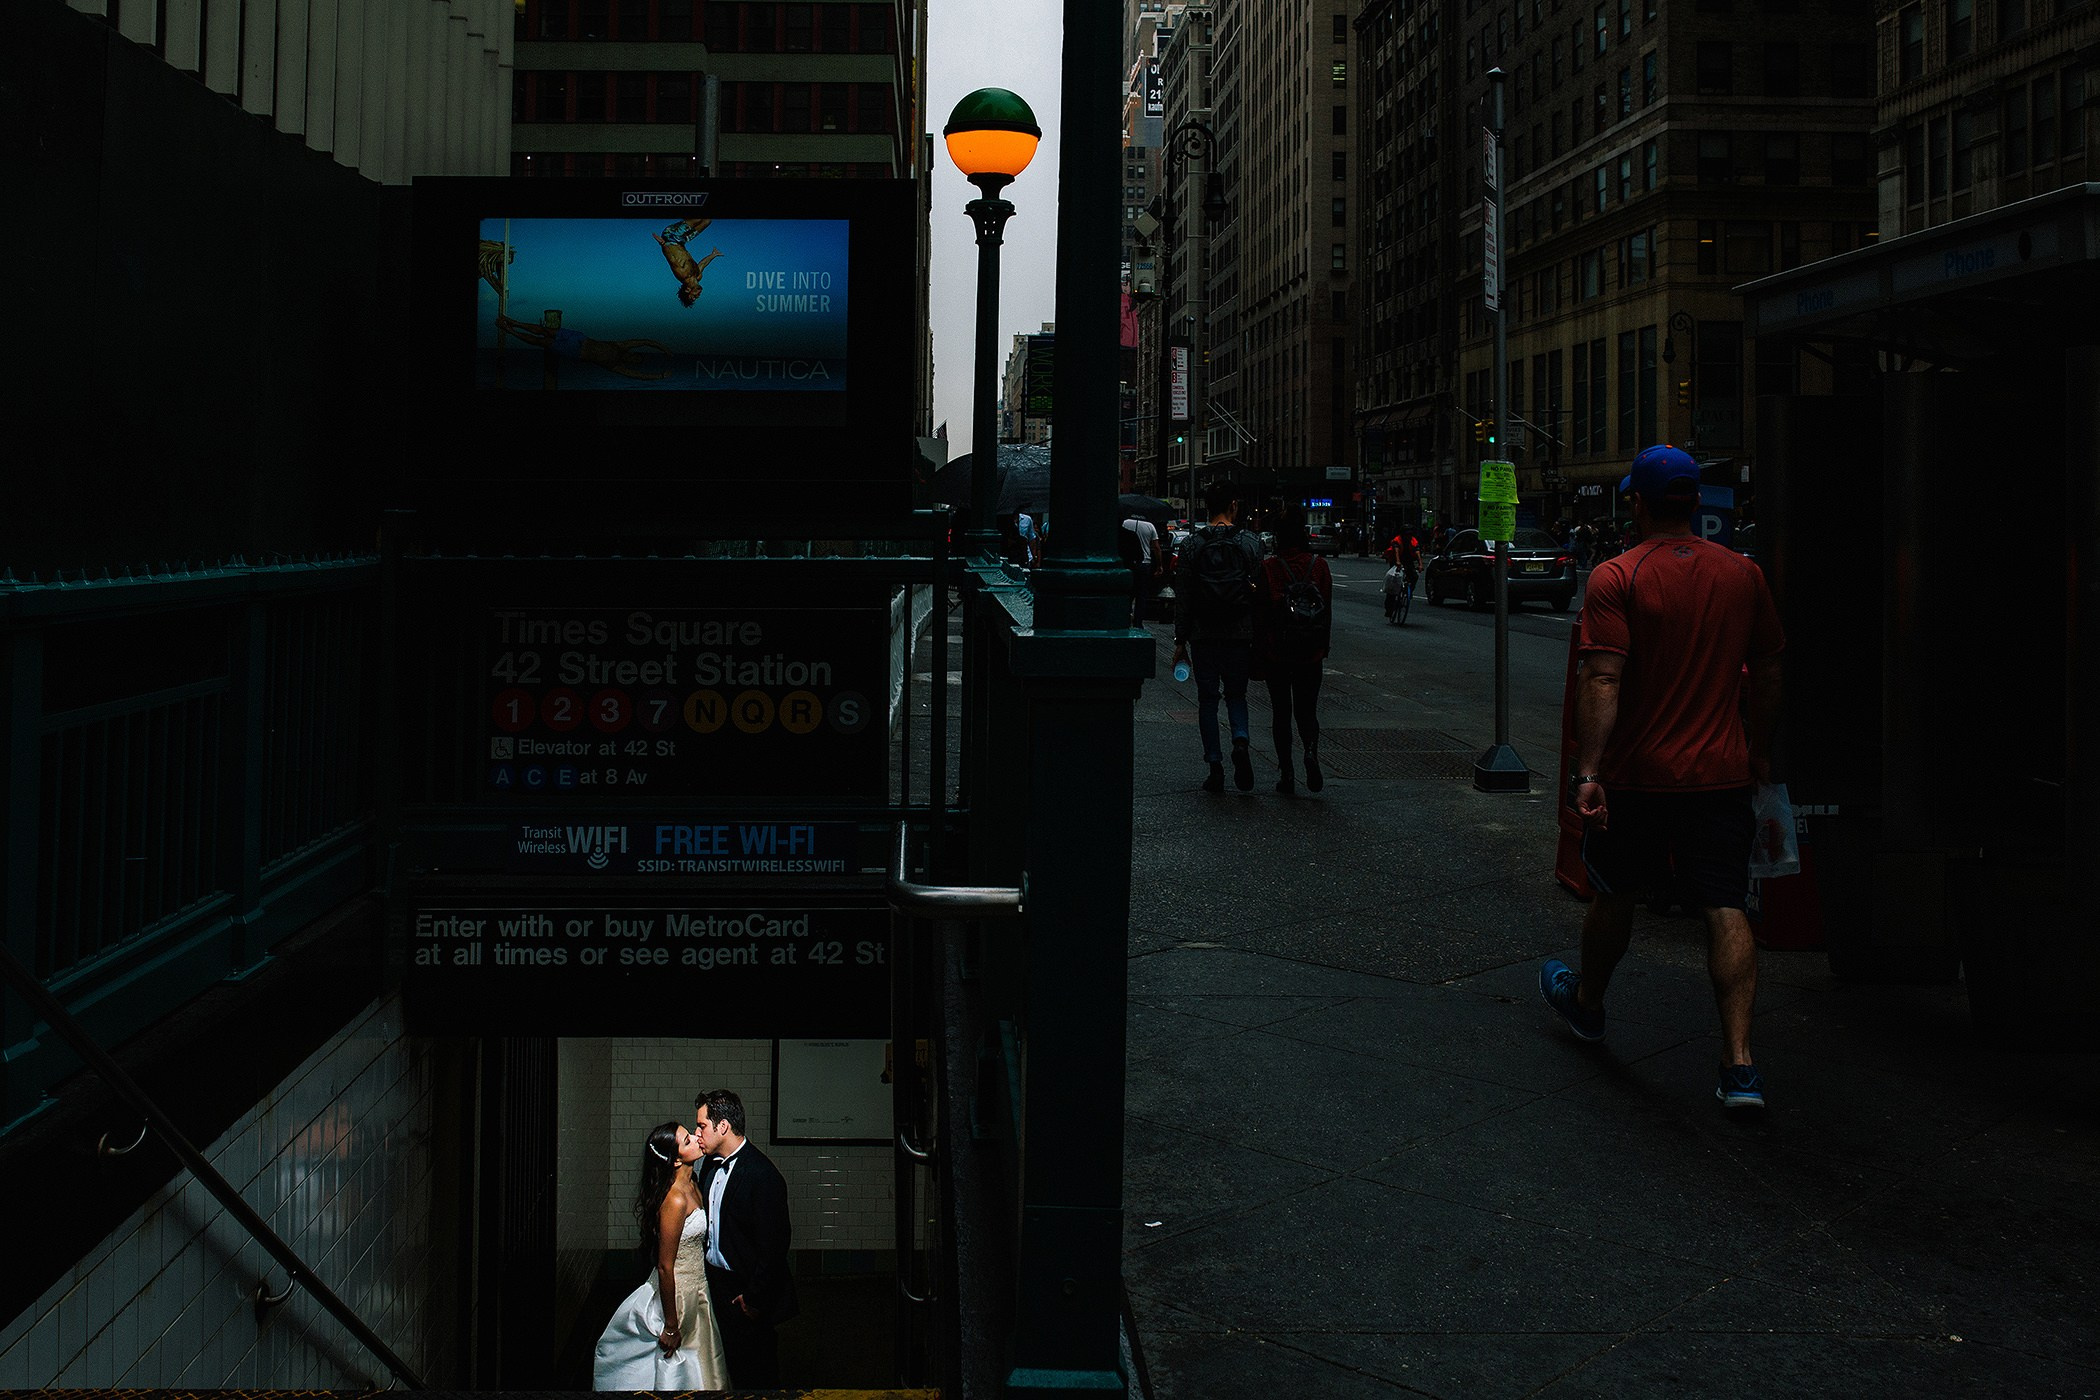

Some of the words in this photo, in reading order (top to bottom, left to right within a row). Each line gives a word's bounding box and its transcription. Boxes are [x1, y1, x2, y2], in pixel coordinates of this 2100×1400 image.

[626, 194, 703, 204] OUTFRONT
[1944, 248, 1995, 277] Phone
[747, 272, 785, 289] DIVE
[794, 272, 830, 289] INTO
[756, 294, 831, 313] SUMMER
[1797, 289, 1834, 313] Phone
[695, 361, 830, 379] NAUTICA
[1702, 515, 1722, 540] P
[495, 612, 608, 644] Times
[626, 612, 762, 654] Square
[492, 652, 541, 683] 42
[559, 650, 677, 684] Street
[695, 652, 831, 686] Station
[507, 699, 518, 722] 1
[554, 697, 571, 720] 2
[601, 698, 619, 722] 3
[650, 700, 667, 724] 7
[694, 698, 716, 723] N
[741, 697, 765, 724] Q
[790, 698, 812, 722] R
[839, 700, 859, 725] S
[519, 739, 591, 755] Elevator
[599, 741, 616, 755] at
[625, 740, 647, 755] 42
[656, 741, 675, 756] St
[496, 769, 509, 783] A
[528, 769, 541, 785] C
[560, 770, 571, 785] E
[580, 770, 597, 783] at
[606, 769, 617, 784] 8
[626, 769, 647, 784] Av
[523, 827, 561, 838] Transit
[656, 826, 728, 854] FREE
[740, 826, 814, 854] WI-FI
[518, 841, 566, 853] Wireless
[638, 860, 674, 871] SSID:
[678, 860, 844, 872] TRANSITWIRELESSWIFI
[416, 915, 486, 937] Enter
[498, 915, 553, 936] with
[566, 920, 593, 937] or
[606, 914, 654, 942] buy
[667, 914, 808, 937] MetroCard
[415, 944, 440, 965] at
[454, 943, 481, 965] all
[494, 942, 567, 965] times
[580, 948, 607, 964] or
[620, 948, 669, 964] see
[682, 943, 758, 970] agent
[771, 943, 796, 964] at
[809, 942, 843, 964] 42
[856, 941, 884, 964] St
